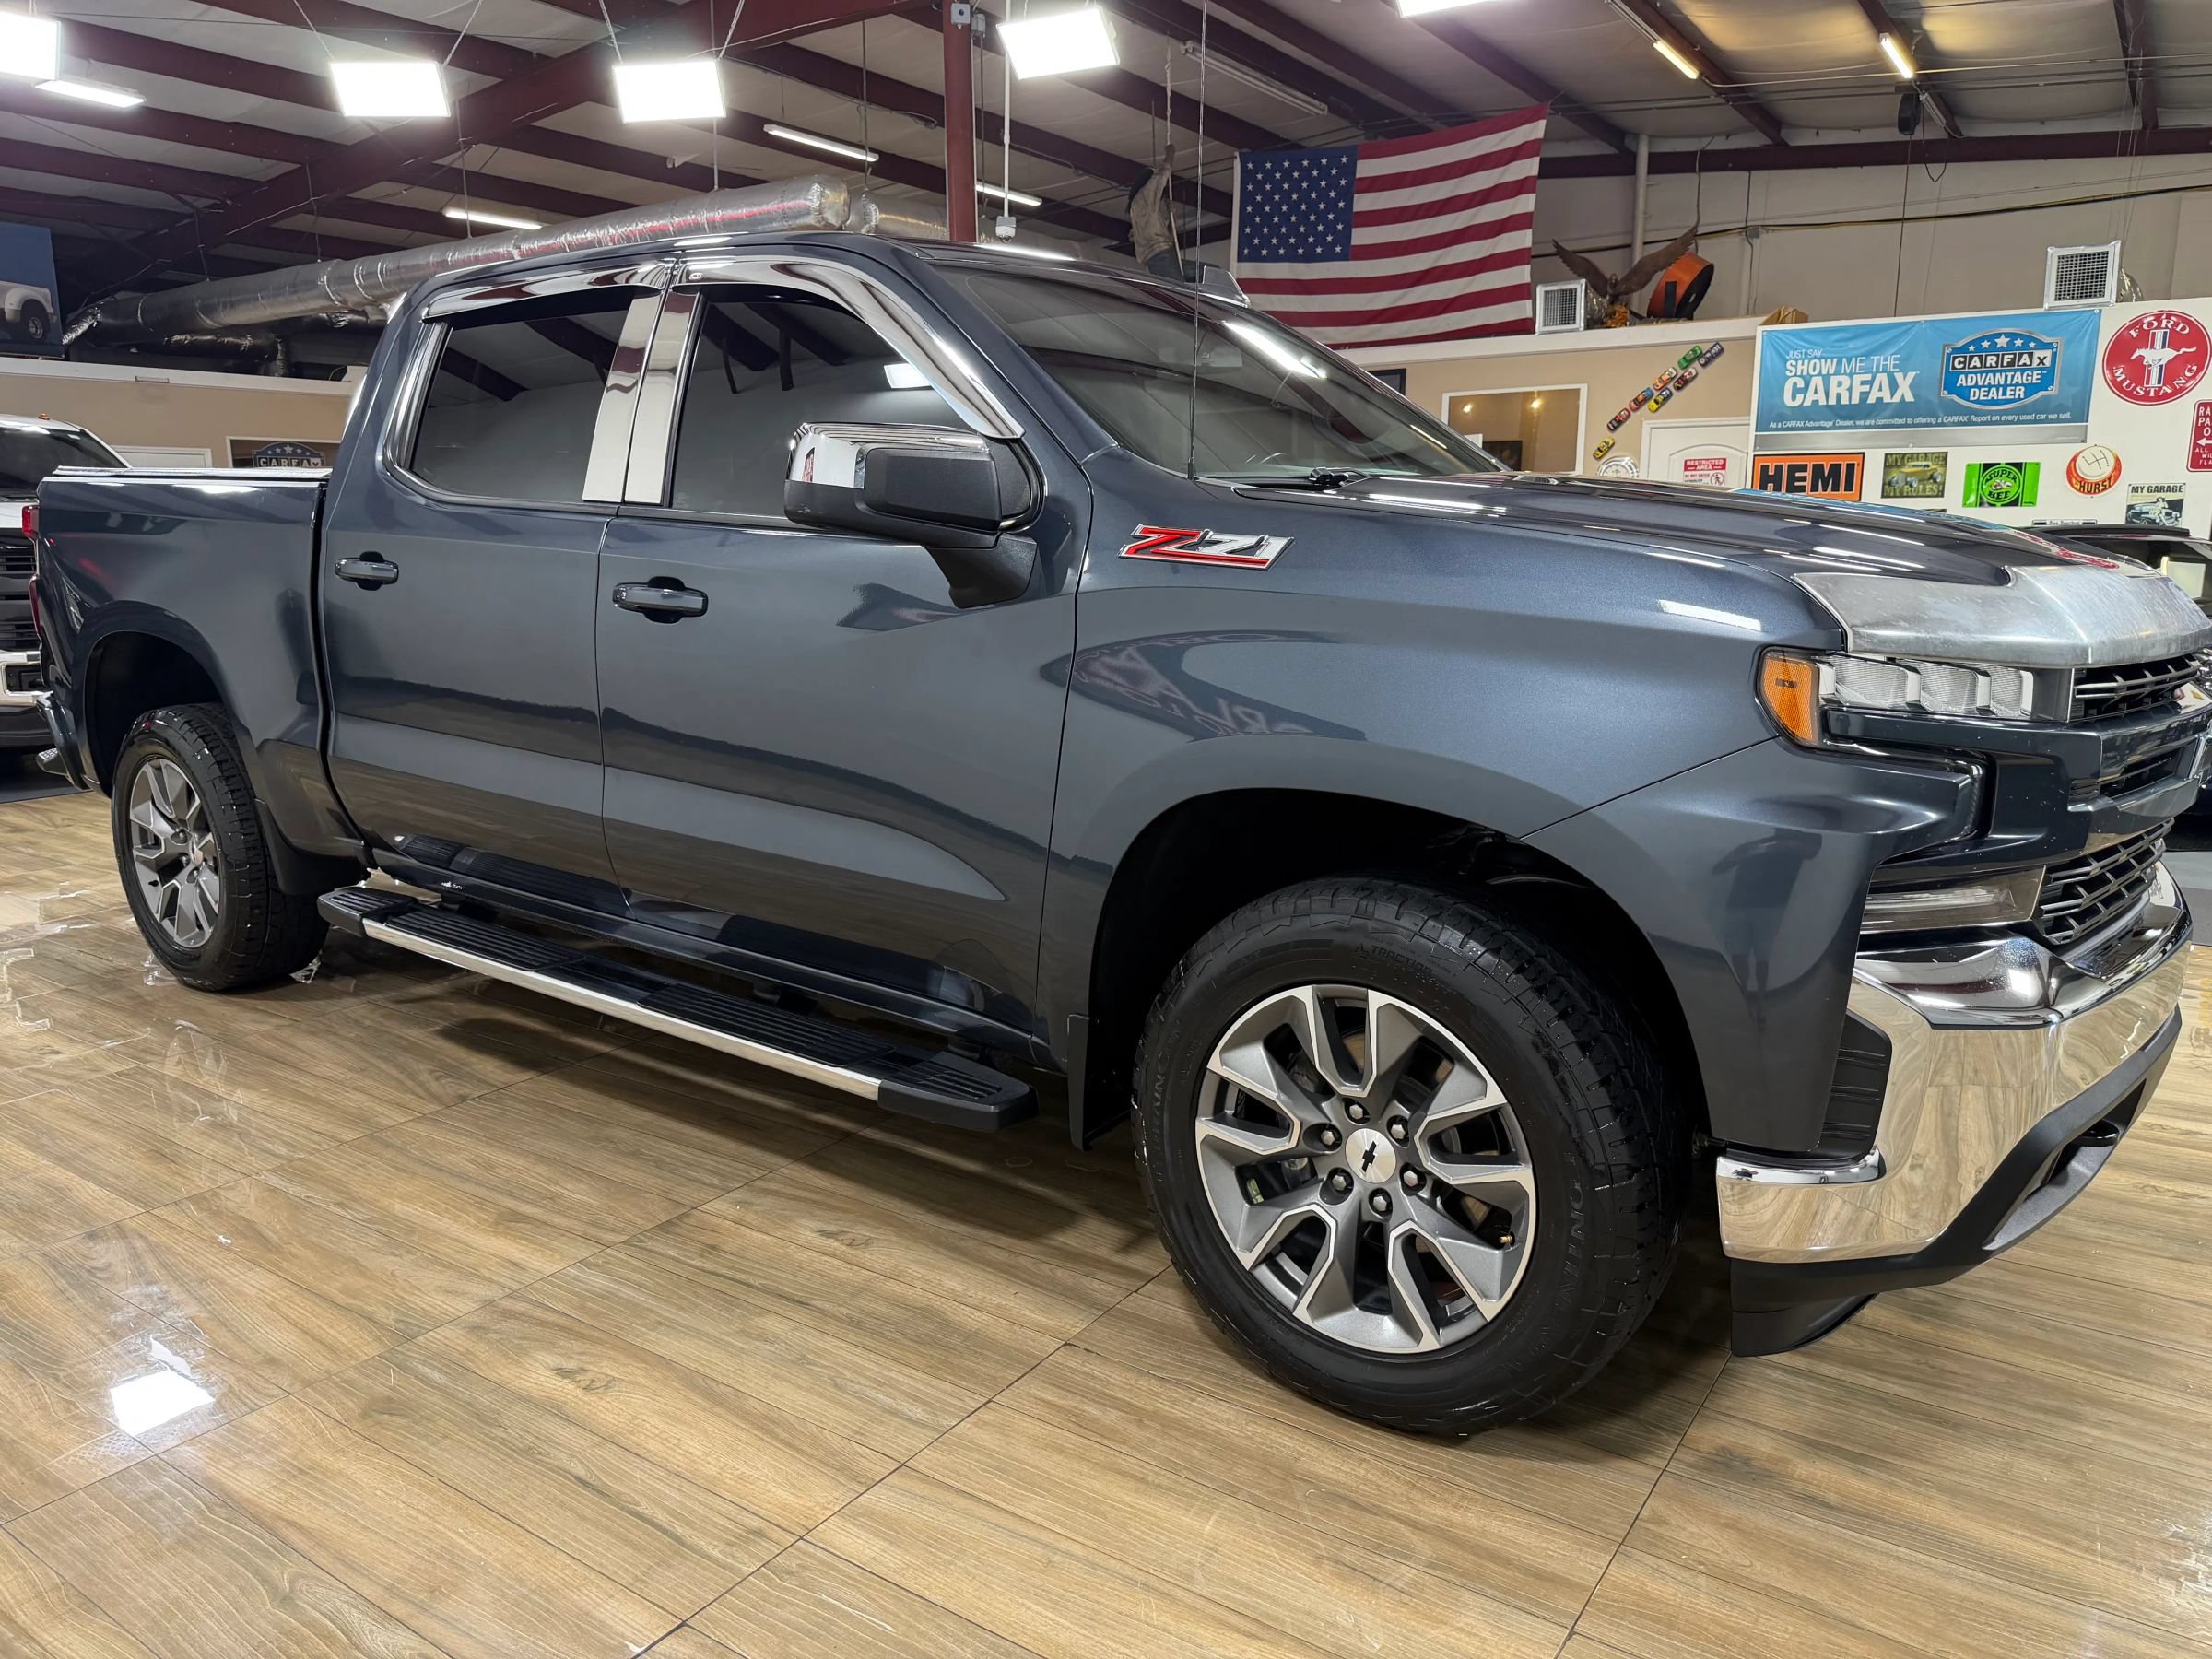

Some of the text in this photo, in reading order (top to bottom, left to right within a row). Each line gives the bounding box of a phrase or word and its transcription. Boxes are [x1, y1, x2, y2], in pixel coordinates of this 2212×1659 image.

[2129, 313, 2190, 338] FORD
[1786, 348, 1823, 359] JUST SAY
[1785, 354, 1900, 376] SHOW ME THE
[1954, 355, 2047, 369] CARFAX
[2112, 364, 2198, 397] MUSTANG
[1783, 371, 1917, 407] CARFAX
[1970, 386, 2025, 401] DEALER
[1876, 417, 1905, 425] committed
[1887, 454, 1902, 466] MY
[1759, 463, 1855, 493] HEMI
[1984, 468, 2018, 484] SUPER
[1883, 485, 1900, 497] MY
[2079, 474, 2114, 494] HURST
[2131, 485, 2183, 494] MY GARAGE
[1987, 490, 2012, 500] BEE
[1118, 524, 1294, 571] Z71
